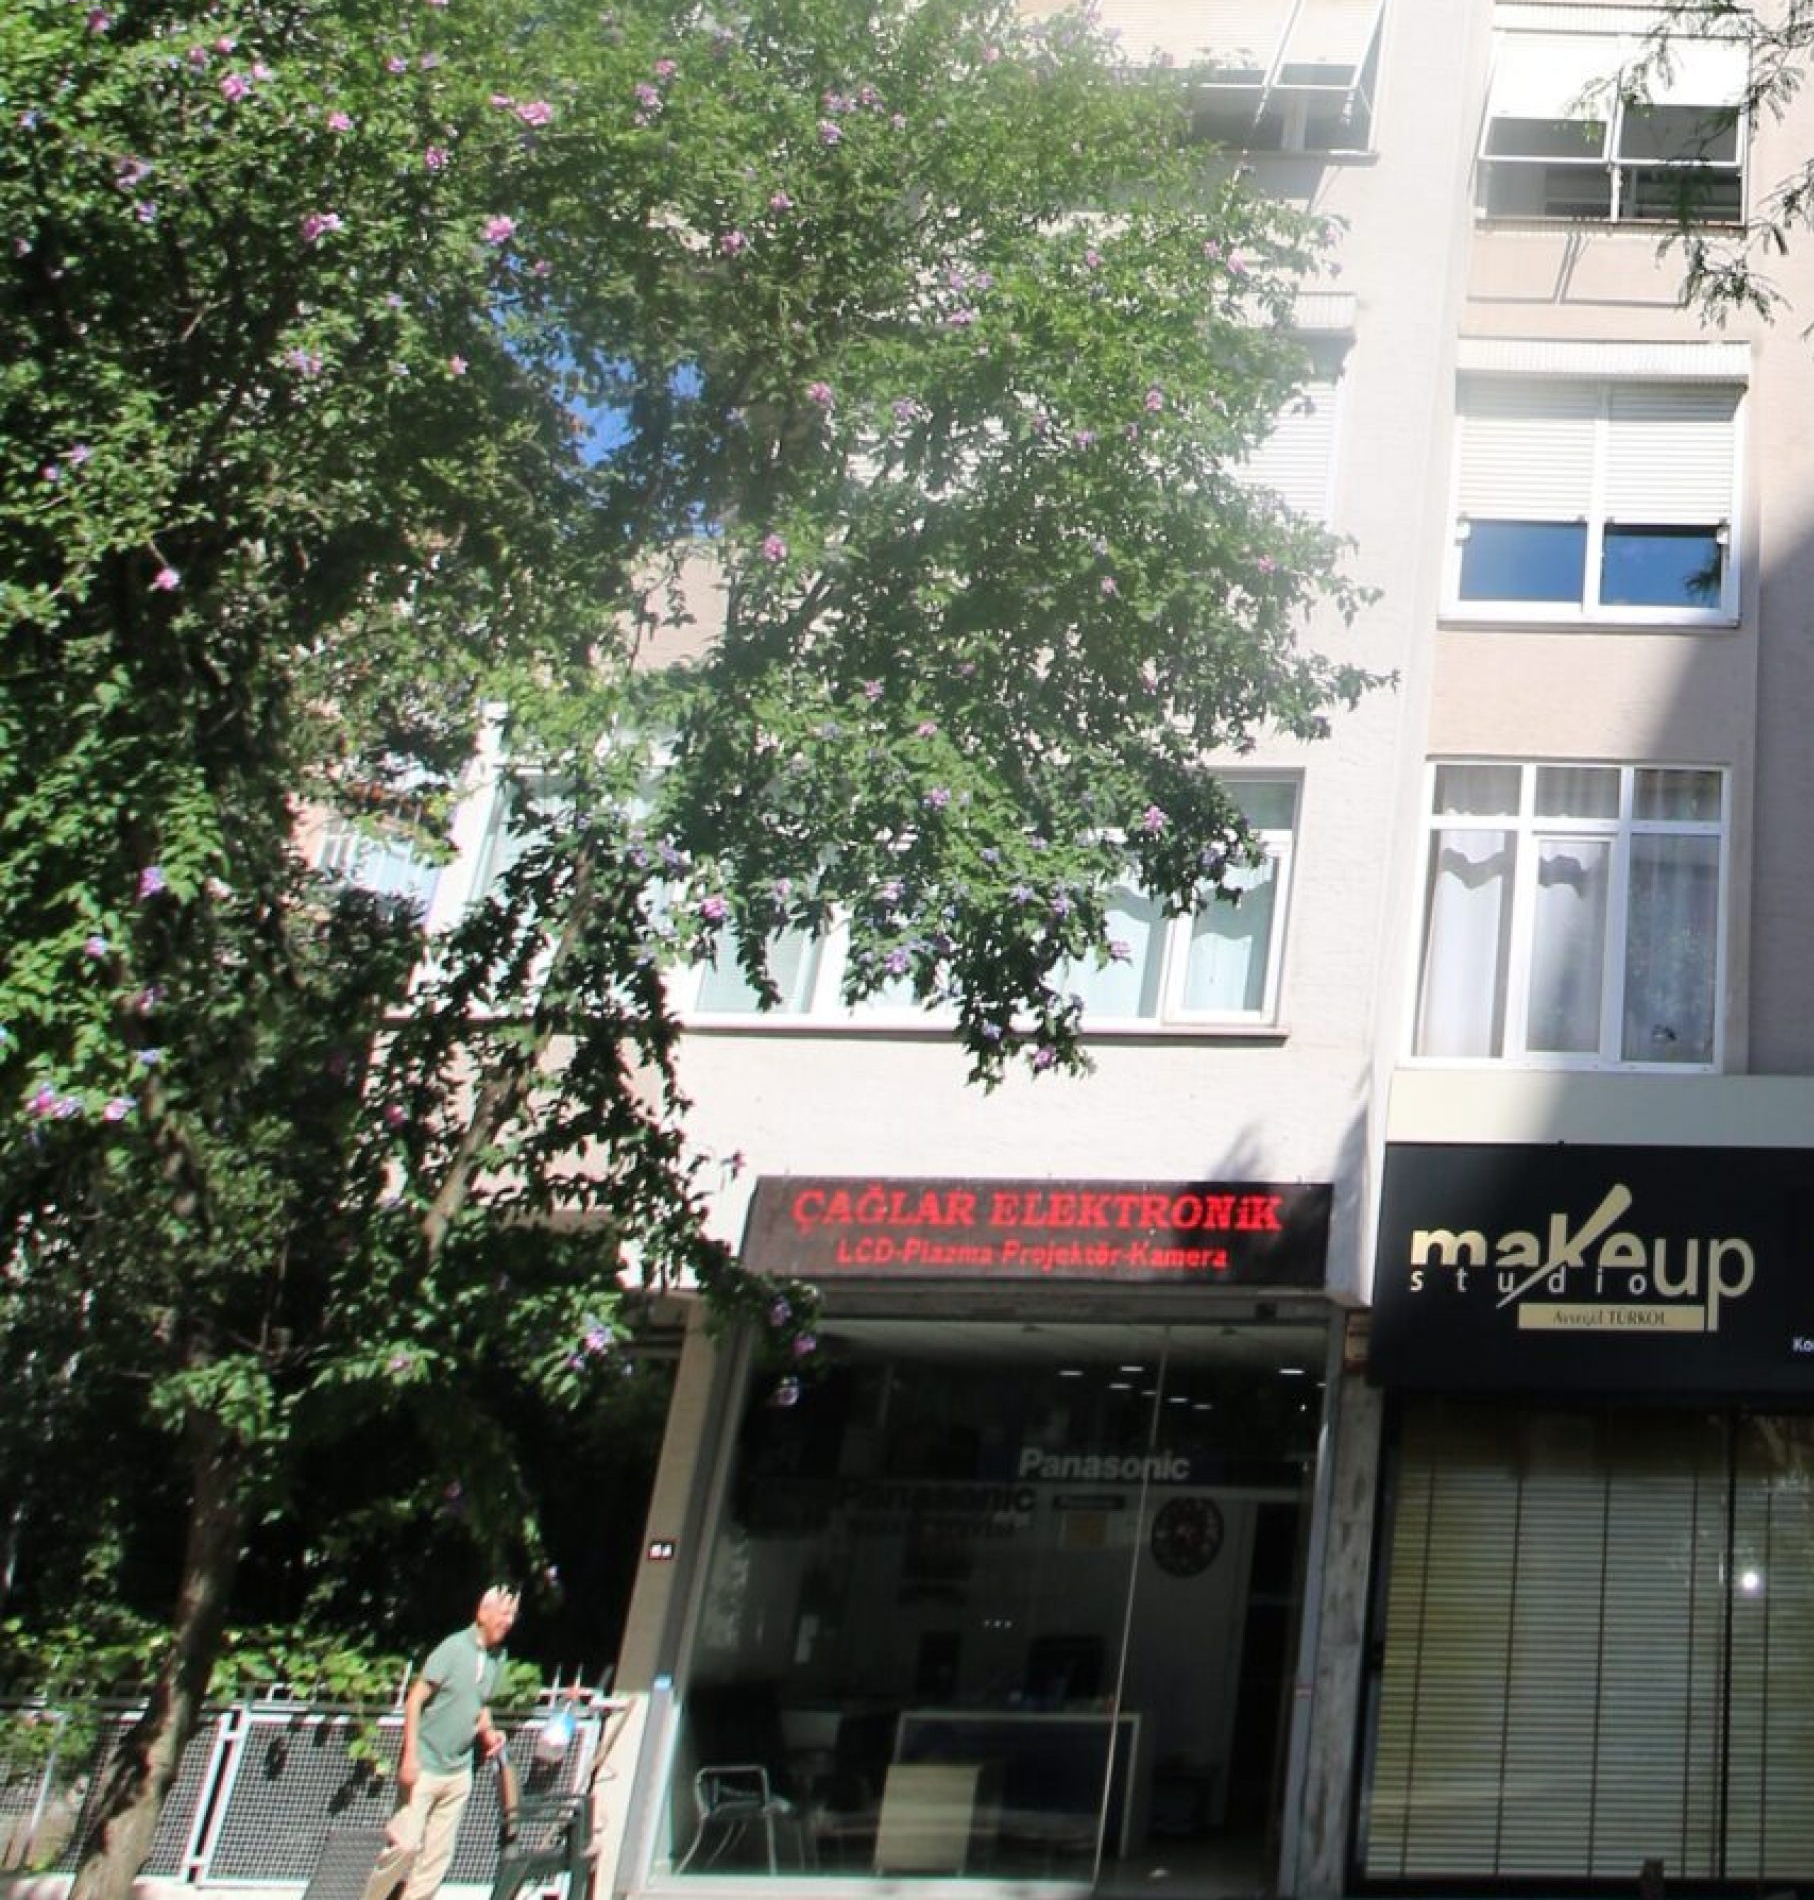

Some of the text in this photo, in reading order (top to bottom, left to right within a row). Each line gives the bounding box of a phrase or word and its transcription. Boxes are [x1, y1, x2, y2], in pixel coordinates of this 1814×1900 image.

[790, 1186, 977, 1237] ÇAĞLAR
[1409, 1267, 1647, 1294] studio
[1017, 1446, 1191, 1482] Panasonic
